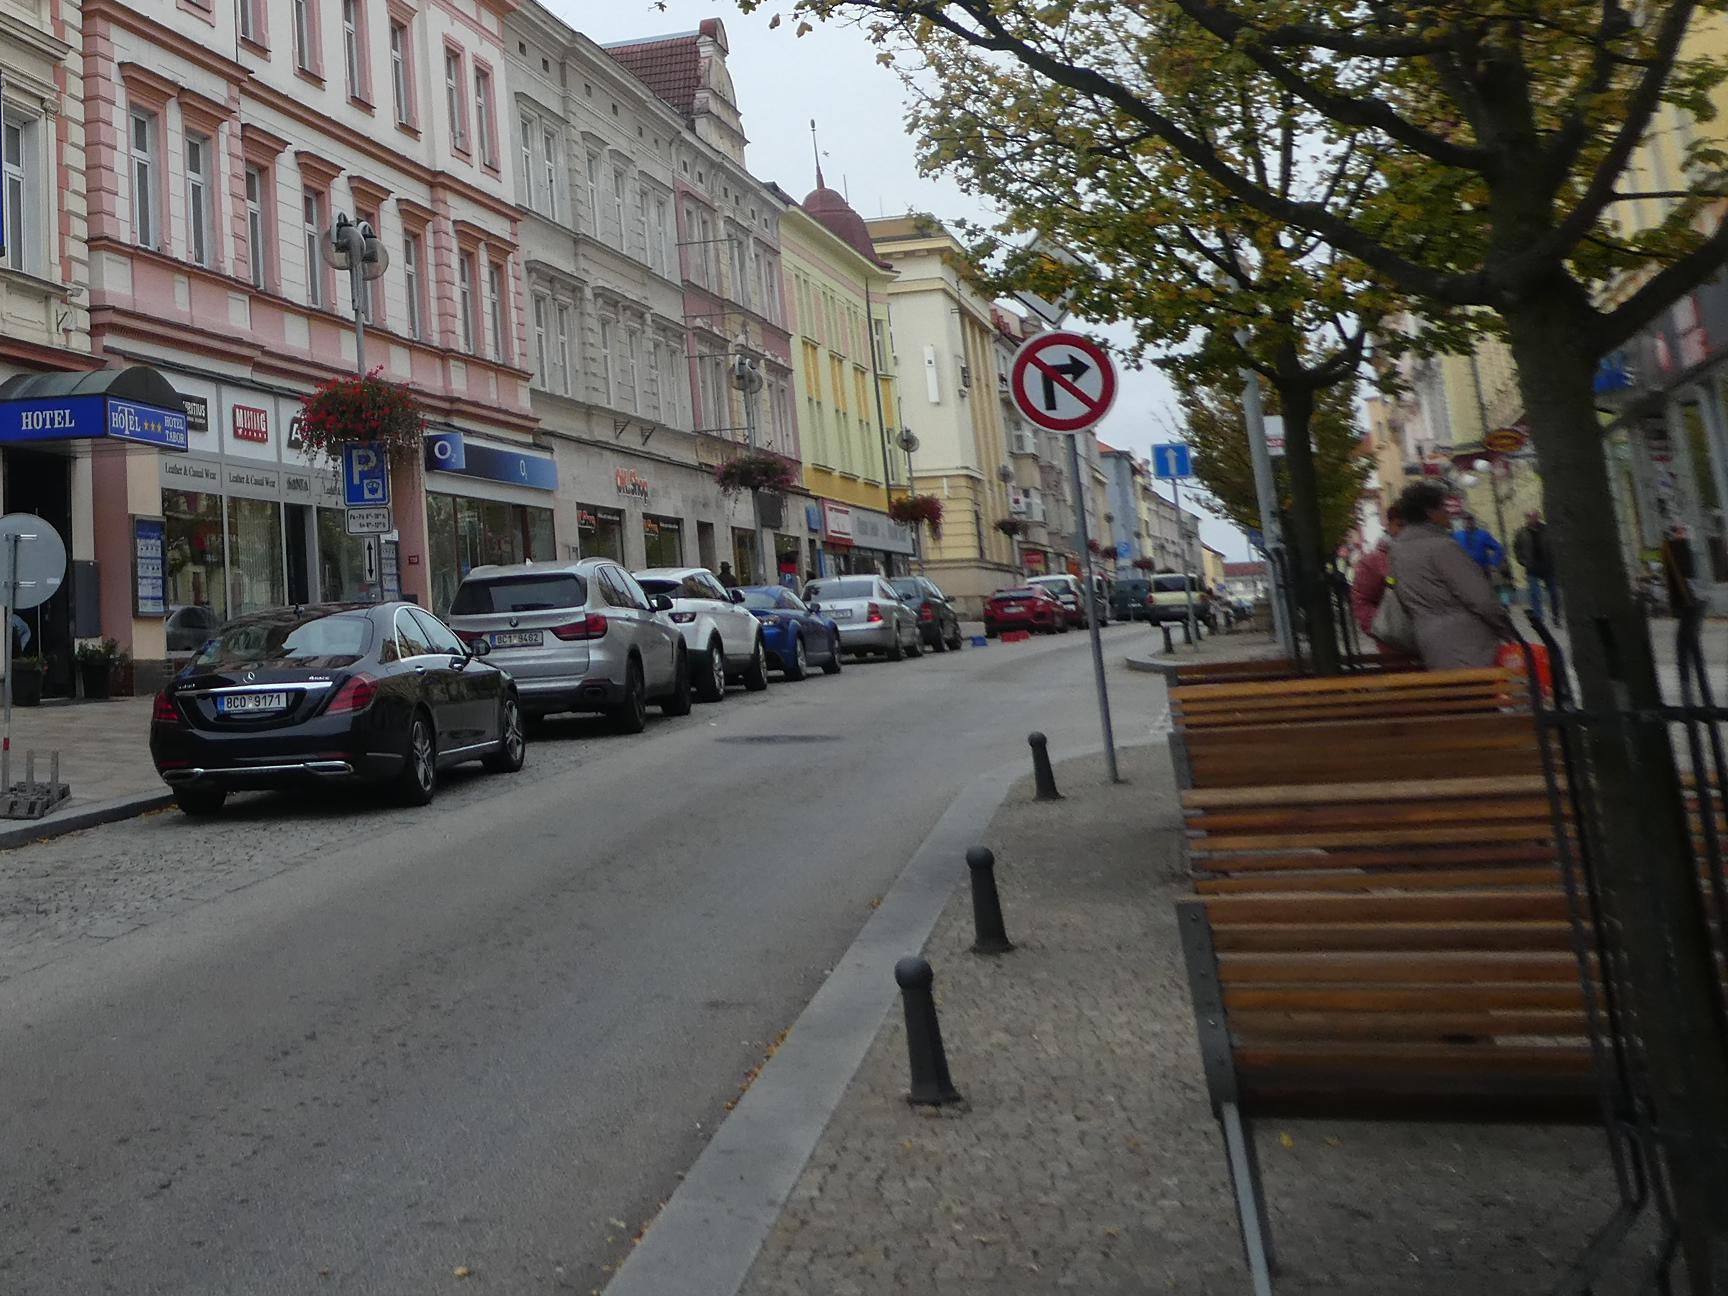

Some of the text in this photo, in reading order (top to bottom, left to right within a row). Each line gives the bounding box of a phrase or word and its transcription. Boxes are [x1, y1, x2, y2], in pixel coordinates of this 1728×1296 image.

[21, 409, 75, 430] HOTEL
[112, 406, 141, 435] HOTEL
[164, 415, 184, 430] HOTEL
[352, 449, 377, 485] P
[227, 693, 282, 709] 8C0 9171
